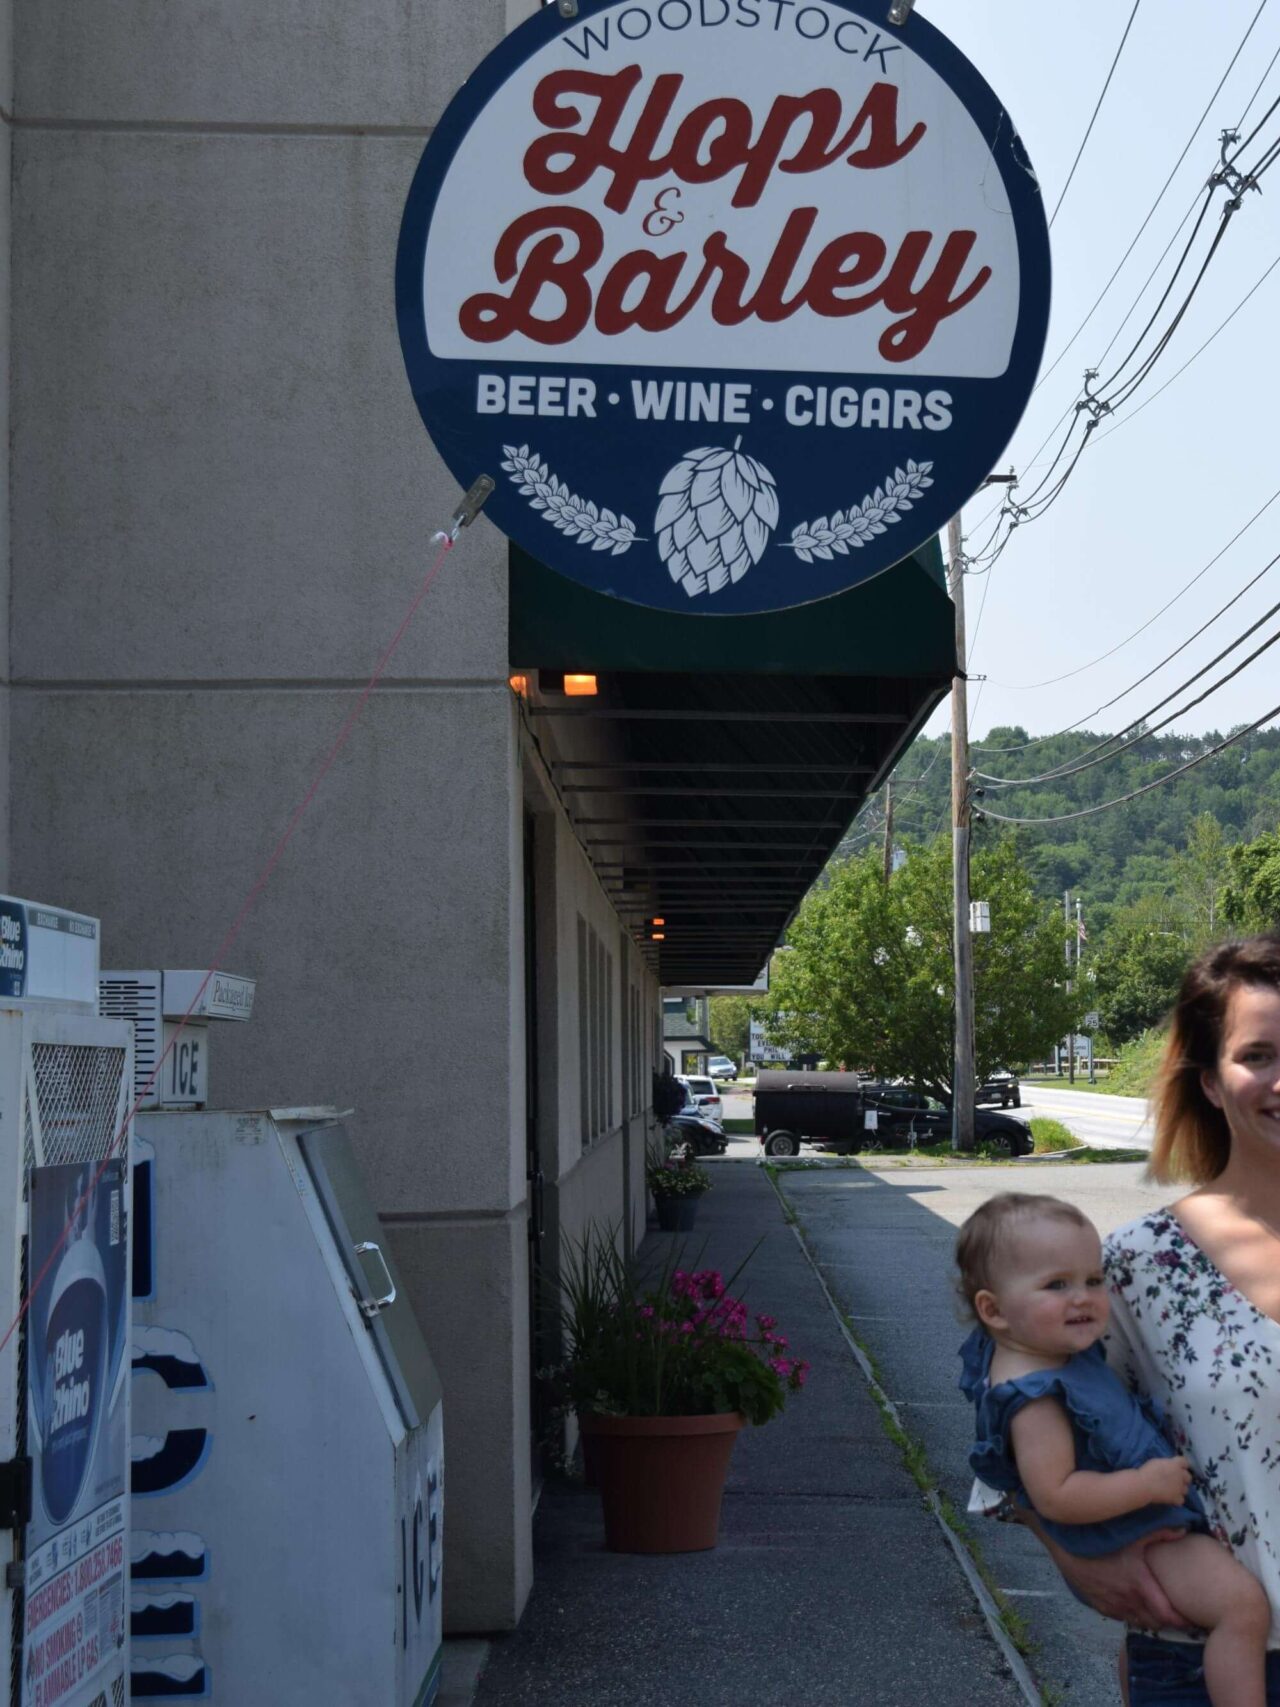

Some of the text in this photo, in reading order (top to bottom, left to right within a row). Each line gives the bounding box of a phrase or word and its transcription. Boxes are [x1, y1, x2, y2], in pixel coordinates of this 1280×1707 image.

[562, 0, 902, 75] WOODSTOCK
[523, 63, 927, 214] Hops
[642, 187, 684, 237] &
[459, 207, 992, 363] Barley
[476, 374, 953, 432] BEER WINE CIGARS
[1, 915, 20, 942] Blue
[213, 980, 245, 1011] Packaged
[172, 1040, 199, 1096] ICE
[55, 1328, 85, 1380] Blue
[401, 1460, 441, 1651] ICE
[35, 1616, 76, 1680] NO SMOKING
[35, 1653, 76, 1707] FLAMMABLE
[86, 1634, 99, 1673] GAS
